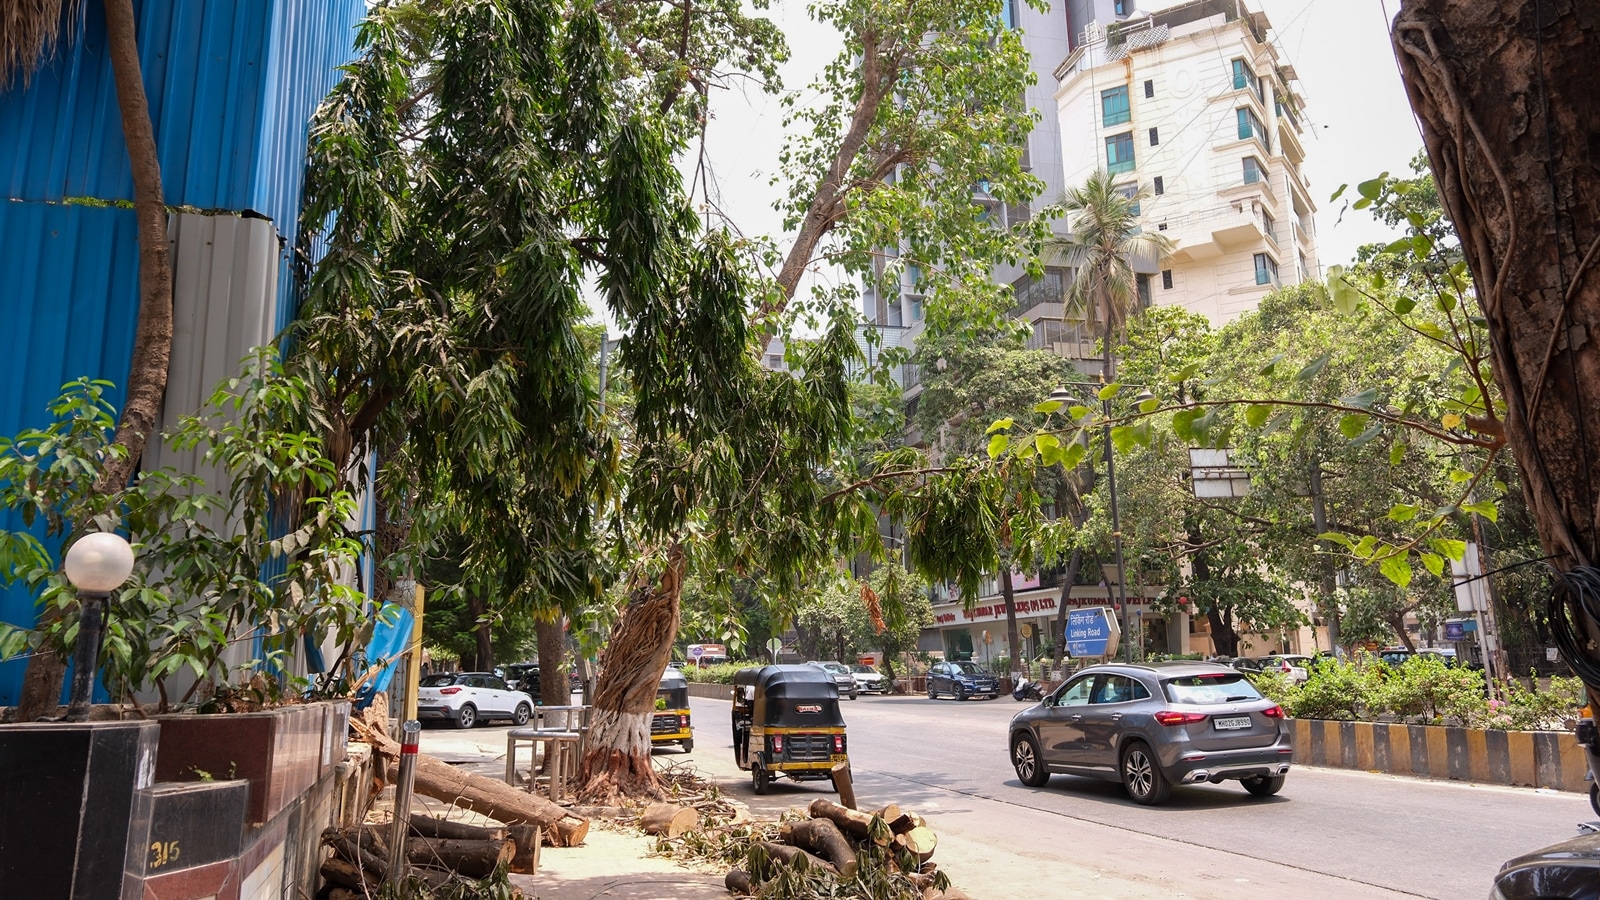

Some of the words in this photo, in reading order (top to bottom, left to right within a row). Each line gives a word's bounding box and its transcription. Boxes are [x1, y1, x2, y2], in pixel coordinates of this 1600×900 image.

[1039, 598, 1057, 609] LTD.
[1085, 613, 1094, 625] रोड
[1070, 629, 1087, 639] Linking
[1087, 627, 1101, 637] Road
[150, 840, 180, 869] 315
